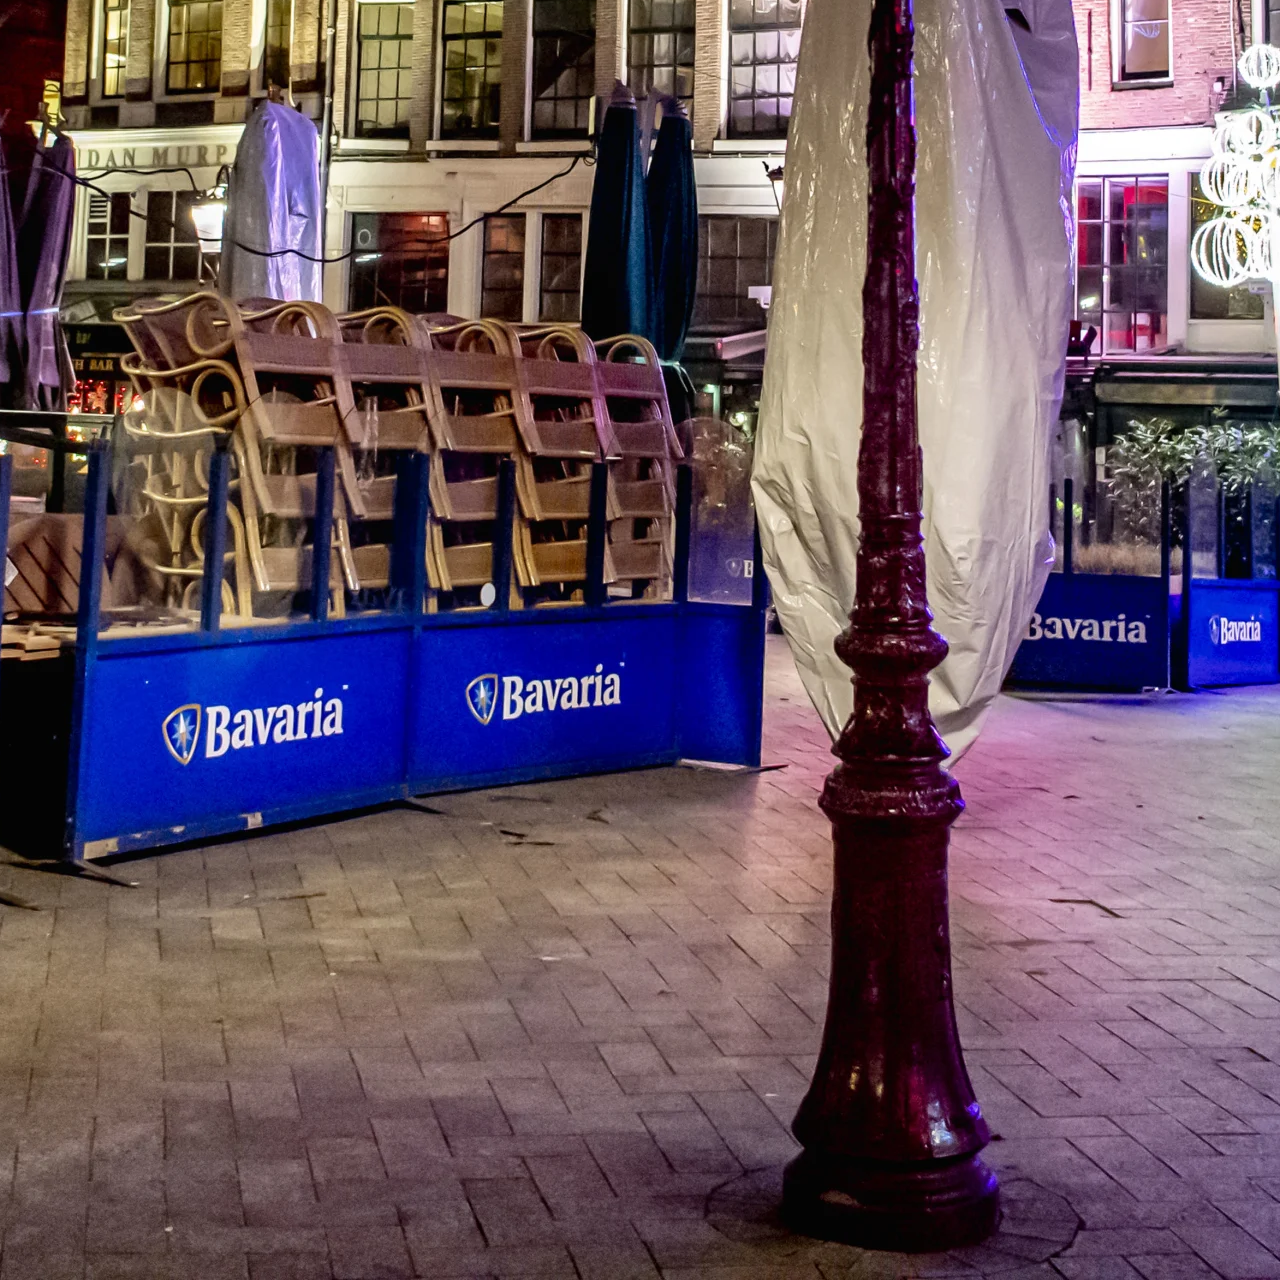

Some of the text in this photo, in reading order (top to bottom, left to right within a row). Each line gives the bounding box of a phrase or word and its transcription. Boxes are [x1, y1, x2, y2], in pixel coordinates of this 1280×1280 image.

[88, 144, 228, 168] DAN MURP
[89, 359, 114, 371] BAR
[1023, 613, 1148, 644] Bavaria
[1220, 614, 1261, 645] Bavaria
[502, 662, 621, 721] Bavaria
[205, 687, 345, 758] Bavaria
